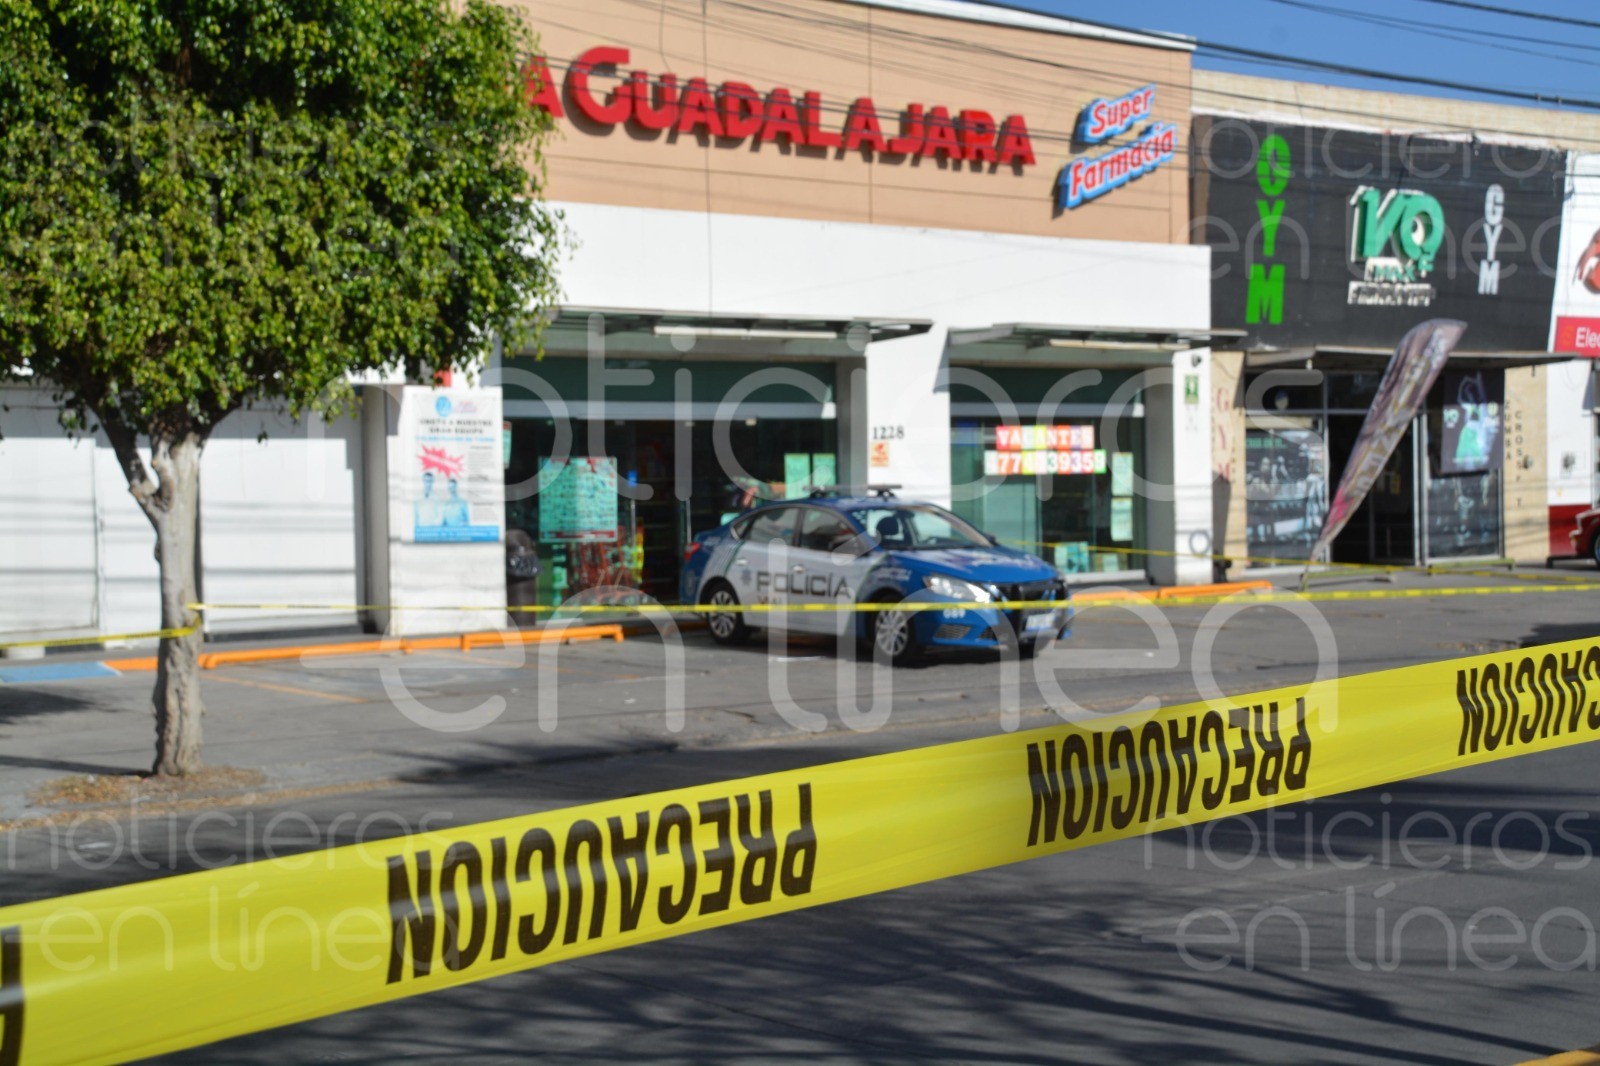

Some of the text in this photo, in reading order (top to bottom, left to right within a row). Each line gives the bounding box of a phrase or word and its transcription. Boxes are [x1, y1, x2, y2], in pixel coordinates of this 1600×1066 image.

[1091, 89, 1152, 134] Super
[1072, 125, 1173, 197] Farmacia
[1478, 184, 1505, 295] GYM
[873, 425, 904, 440] 1228
[1026, 696, 1312, 849] PRECAUCION
[386, 782, 817, 986] PRECAUCION
